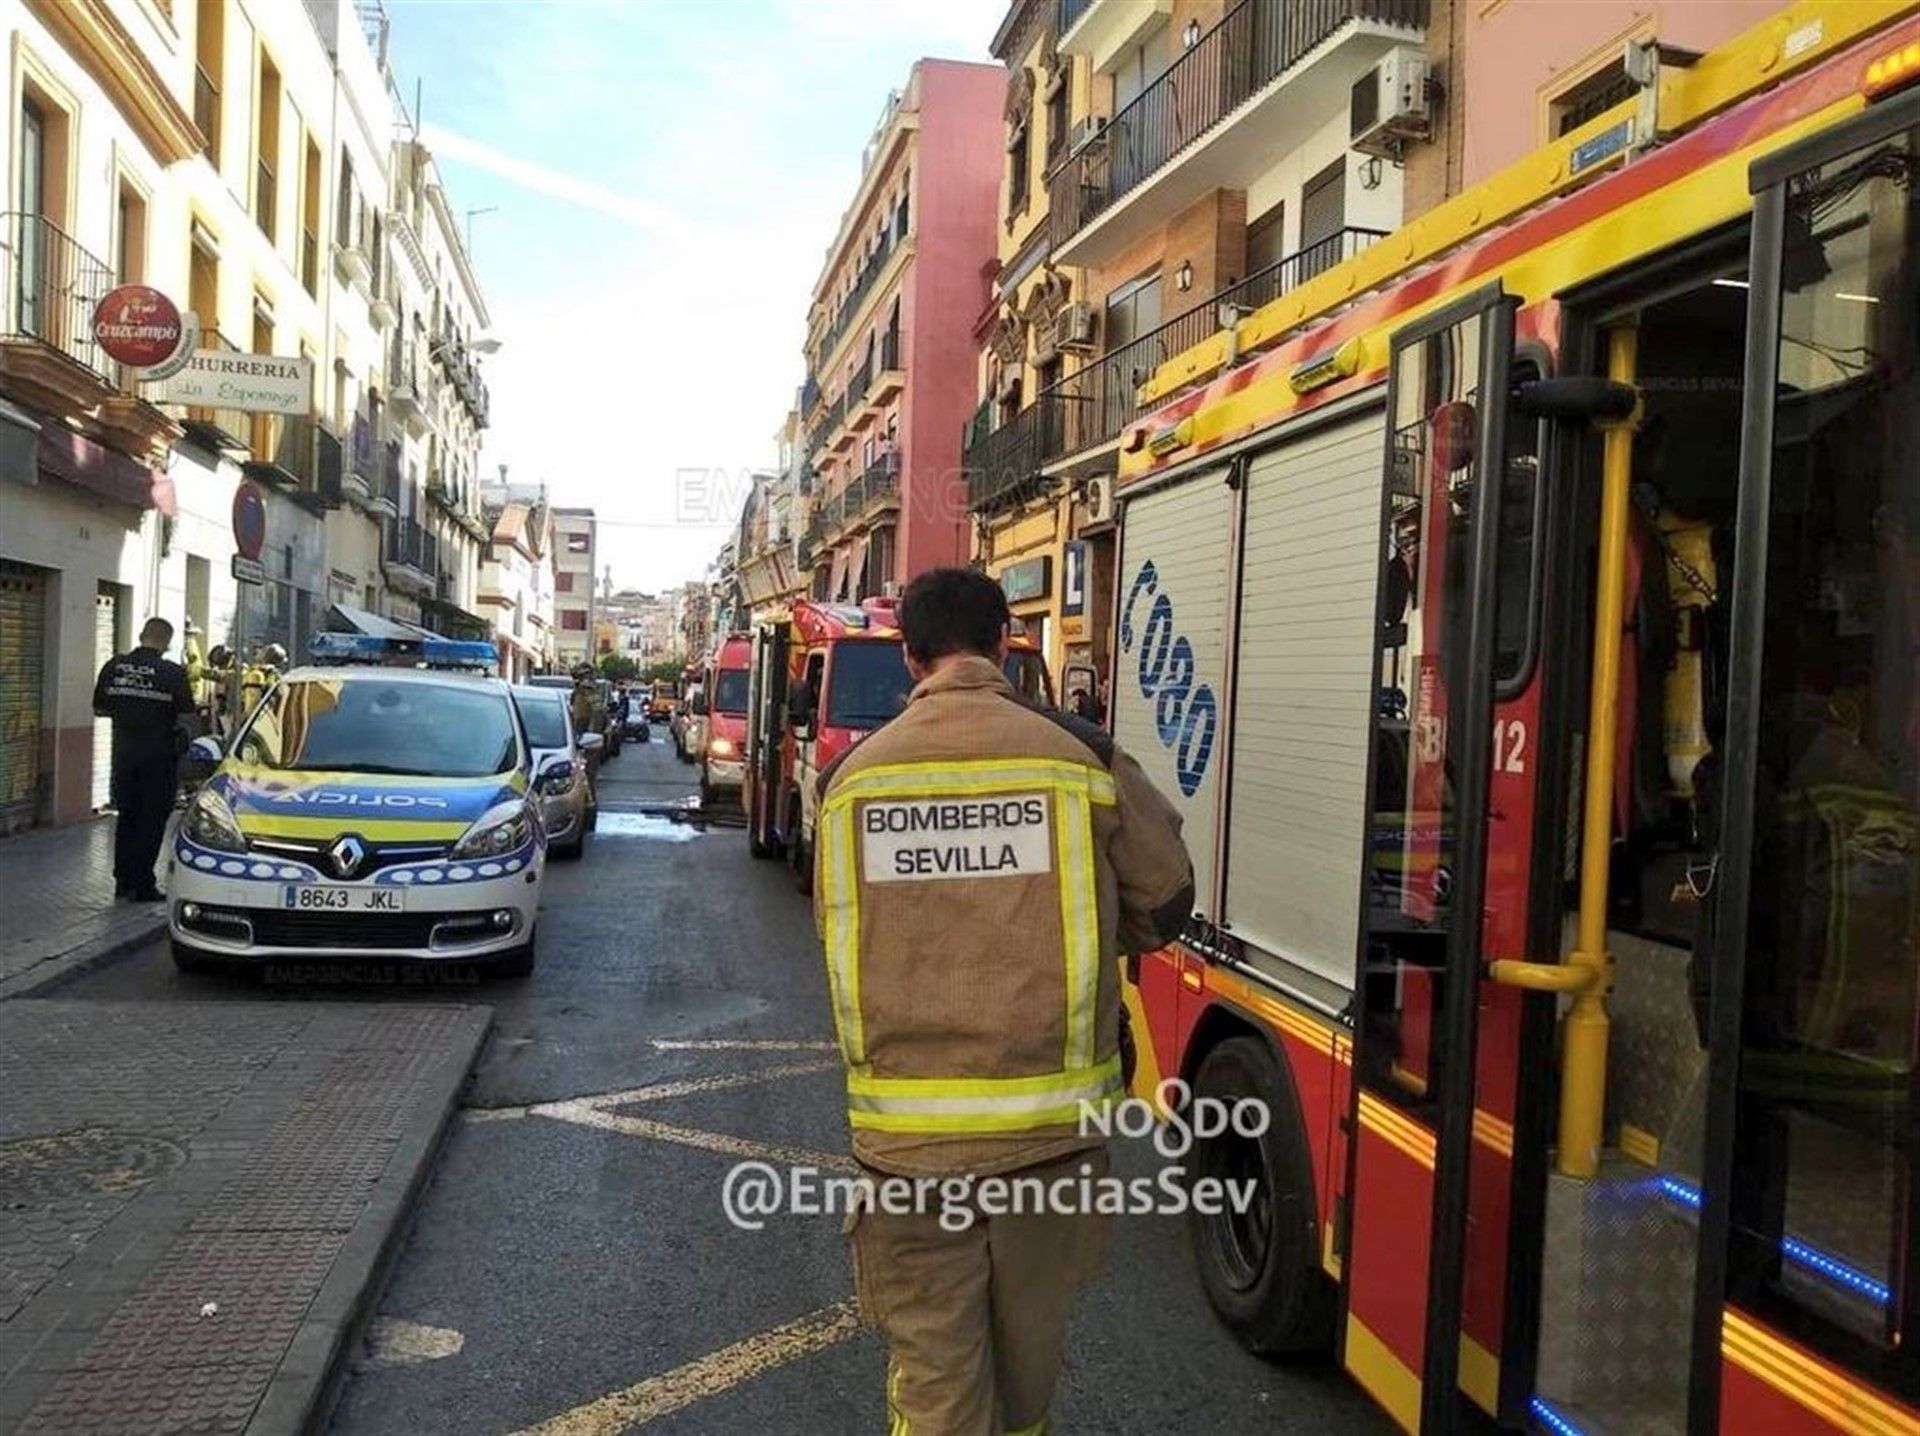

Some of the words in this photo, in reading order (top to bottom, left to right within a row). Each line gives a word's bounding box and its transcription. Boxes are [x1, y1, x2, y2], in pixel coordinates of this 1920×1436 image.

[96, 321, 178, 341] Cruzcampo
[1493, 719, 1526, 773] 12
[866, 800, 1043, 833] BOMBEROS
[895, 844, 1018, 874] SEVILLA
[300, 890, 348, 909] 8643
[364, 892, 400, 911] JKL
